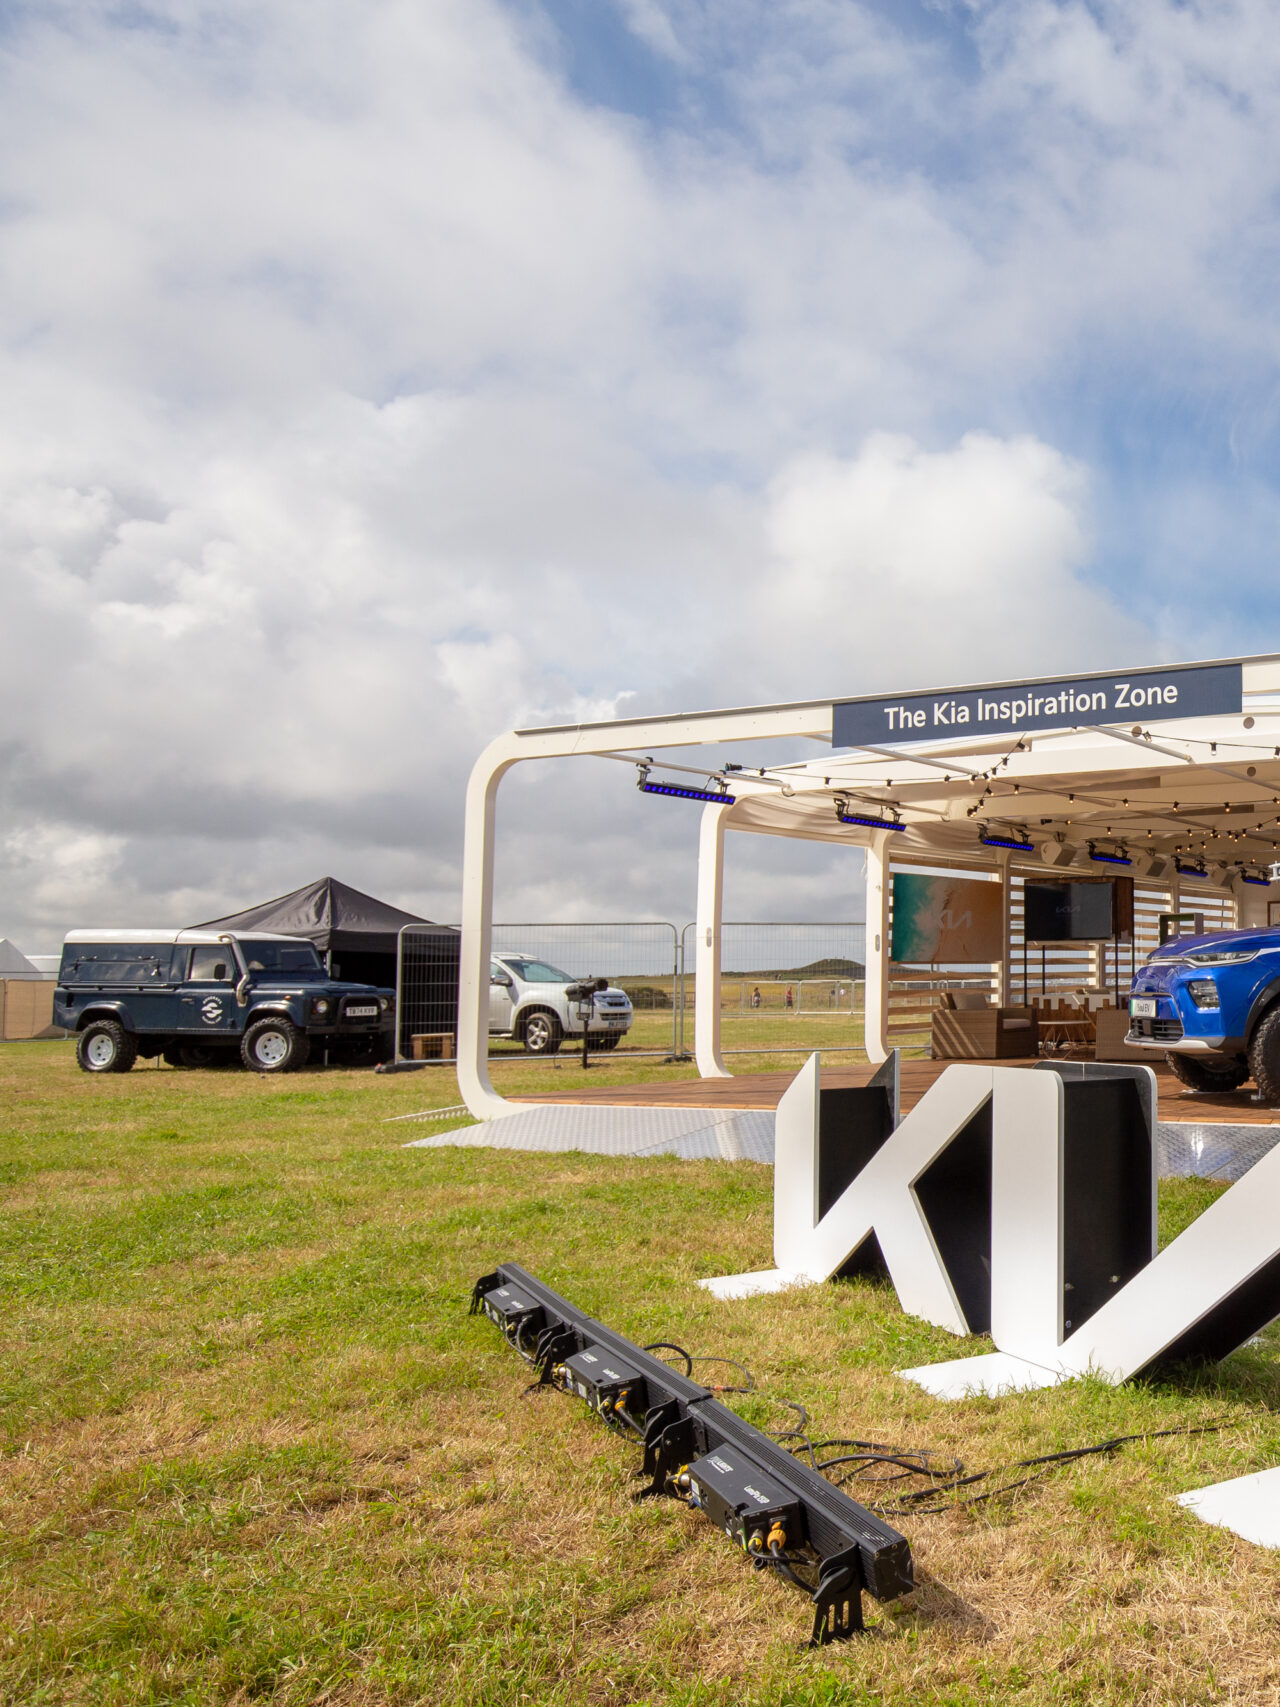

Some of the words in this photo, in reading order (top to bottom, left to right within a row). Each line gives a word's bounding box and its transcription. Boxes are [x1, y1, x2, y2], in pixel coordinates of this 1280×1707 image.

[884, 705, 926, 730] The
[933, 701, 969, 725] Kia
[977, 688, 1107, 723] Inspiration
[1114, 682, 1178, 709] Zone
